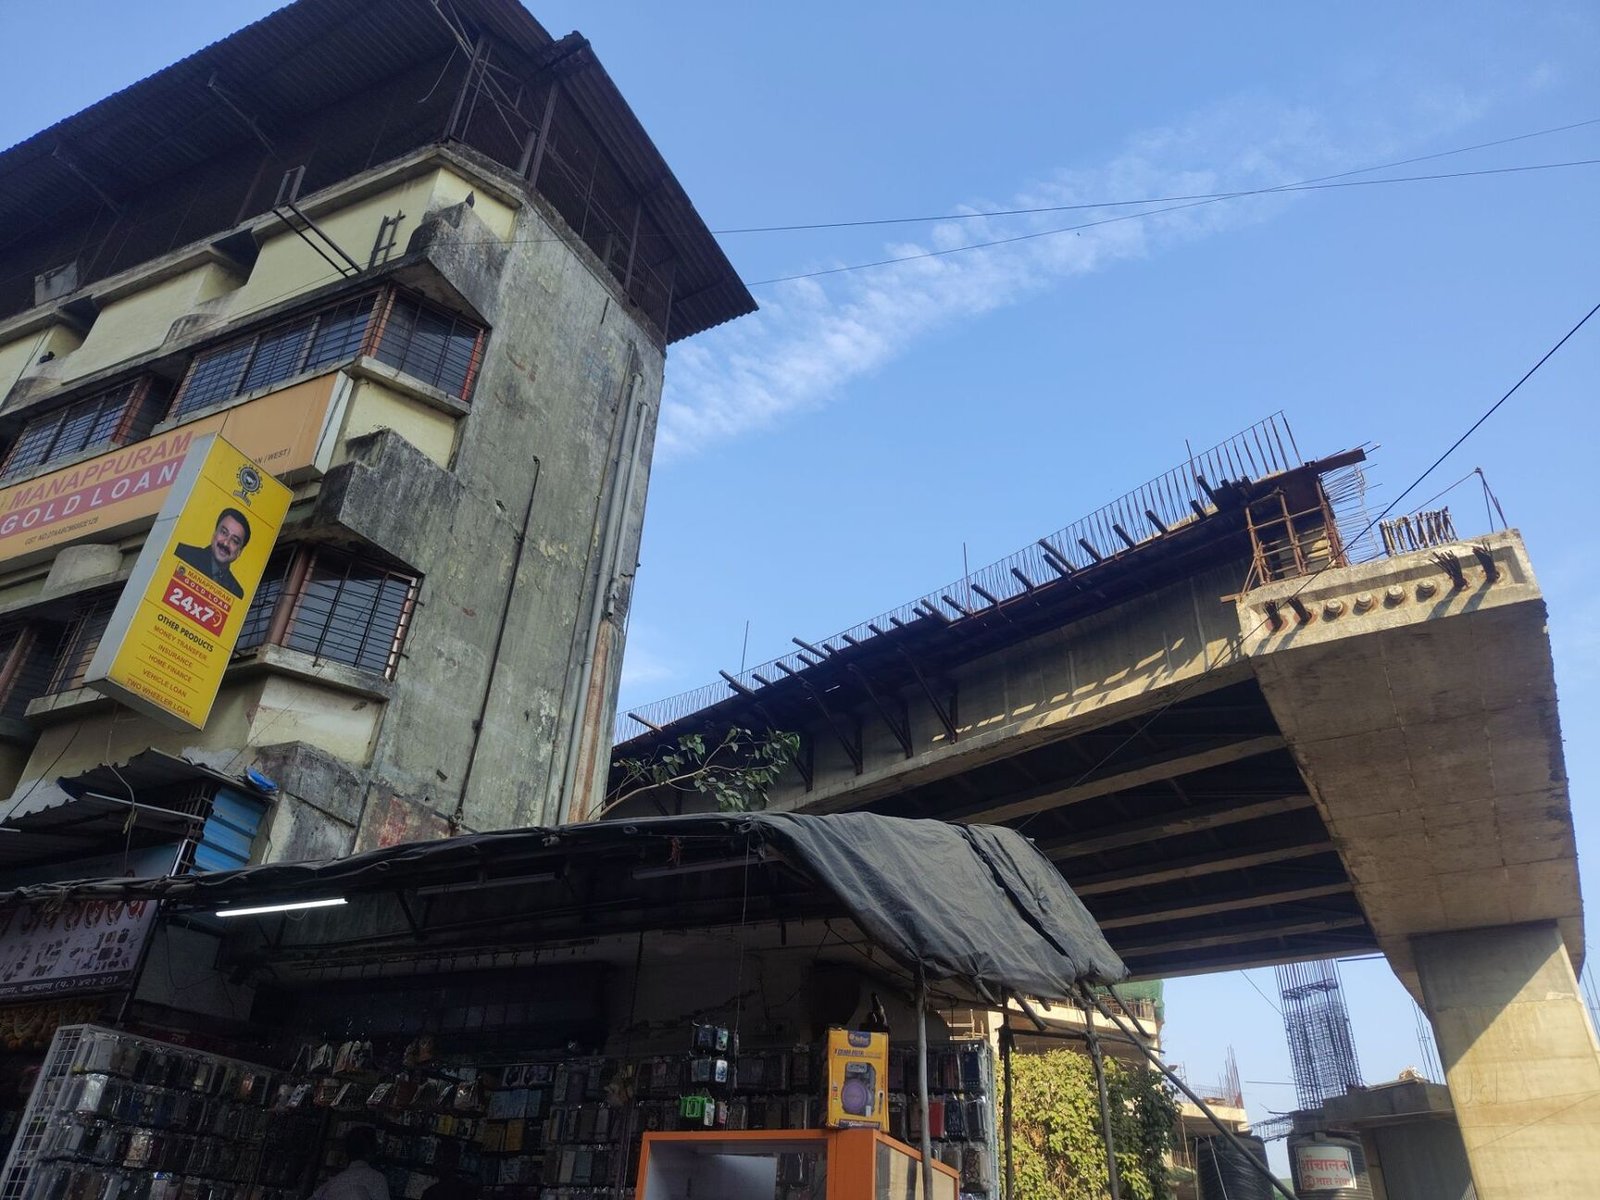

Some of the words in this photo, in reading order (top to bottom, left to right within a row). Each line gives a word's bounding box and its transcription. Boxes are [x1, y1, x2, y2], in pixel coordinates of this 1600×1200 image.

[8, 431, 193, 510] MANAPPURAM
[1, 495, 81, 534] GOLD
[90, 462, 178, 507] LOAN
[184, 578, 206, 594] GOLD
[208, 594, 229, 610] LOAN
[187, 570, 231, 602] MANAPPURAM
[169, 588, 215, 622] 24x7
[154, 625, 176, 641] MONEY
[177, 639, 207, 660] TRANSFER
[157, 613, 180, 631] OTHER
[180, 627, 214, 652] PRODUCTS
[149, 654, 166, 668] HOME
[167, 664, 192, 682] FINANCE
[159, 644, 193, 668] INSURANCE
[127, 678, 141, 690] TWO
[142, 686, 173, 705] WHEELER
[173, 703, 191, 717] LOAN
[143, 668, 169, 688] VEHICLE
[170, 684, 187, 697] LOAN
